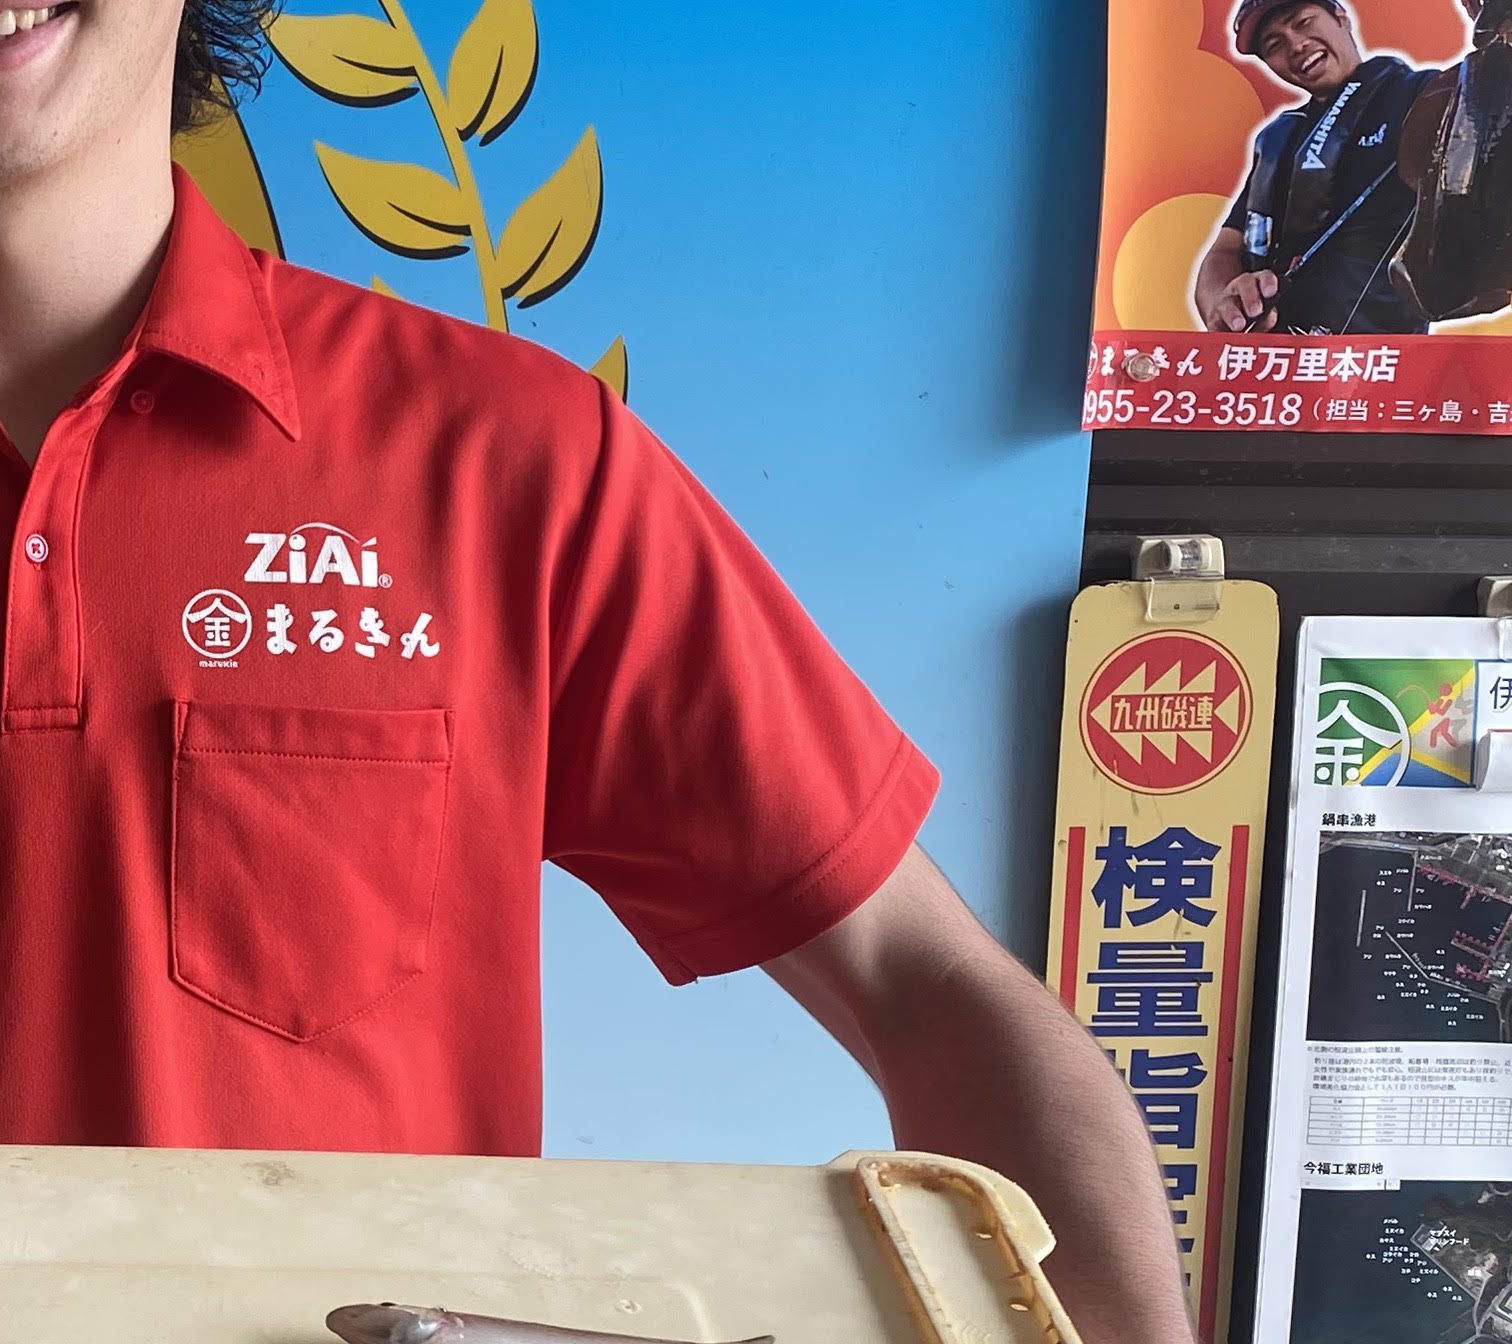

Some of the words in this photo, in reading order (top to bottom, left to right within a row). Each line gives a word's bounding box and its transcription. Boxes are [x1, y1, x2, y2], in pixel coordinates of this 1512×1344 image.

[1301, 81, 1362, 170] YAMASHITA
[1218, 344, 1400, 383] 伊万里本店
[1082, 389, 1303, 425] 955-23-3518
[266, 603, 440, 659] まるきん
[1113, 696, 1213, 730] 九州磯連
[1303, 1161, 1384, 1175] 今福工業団地
